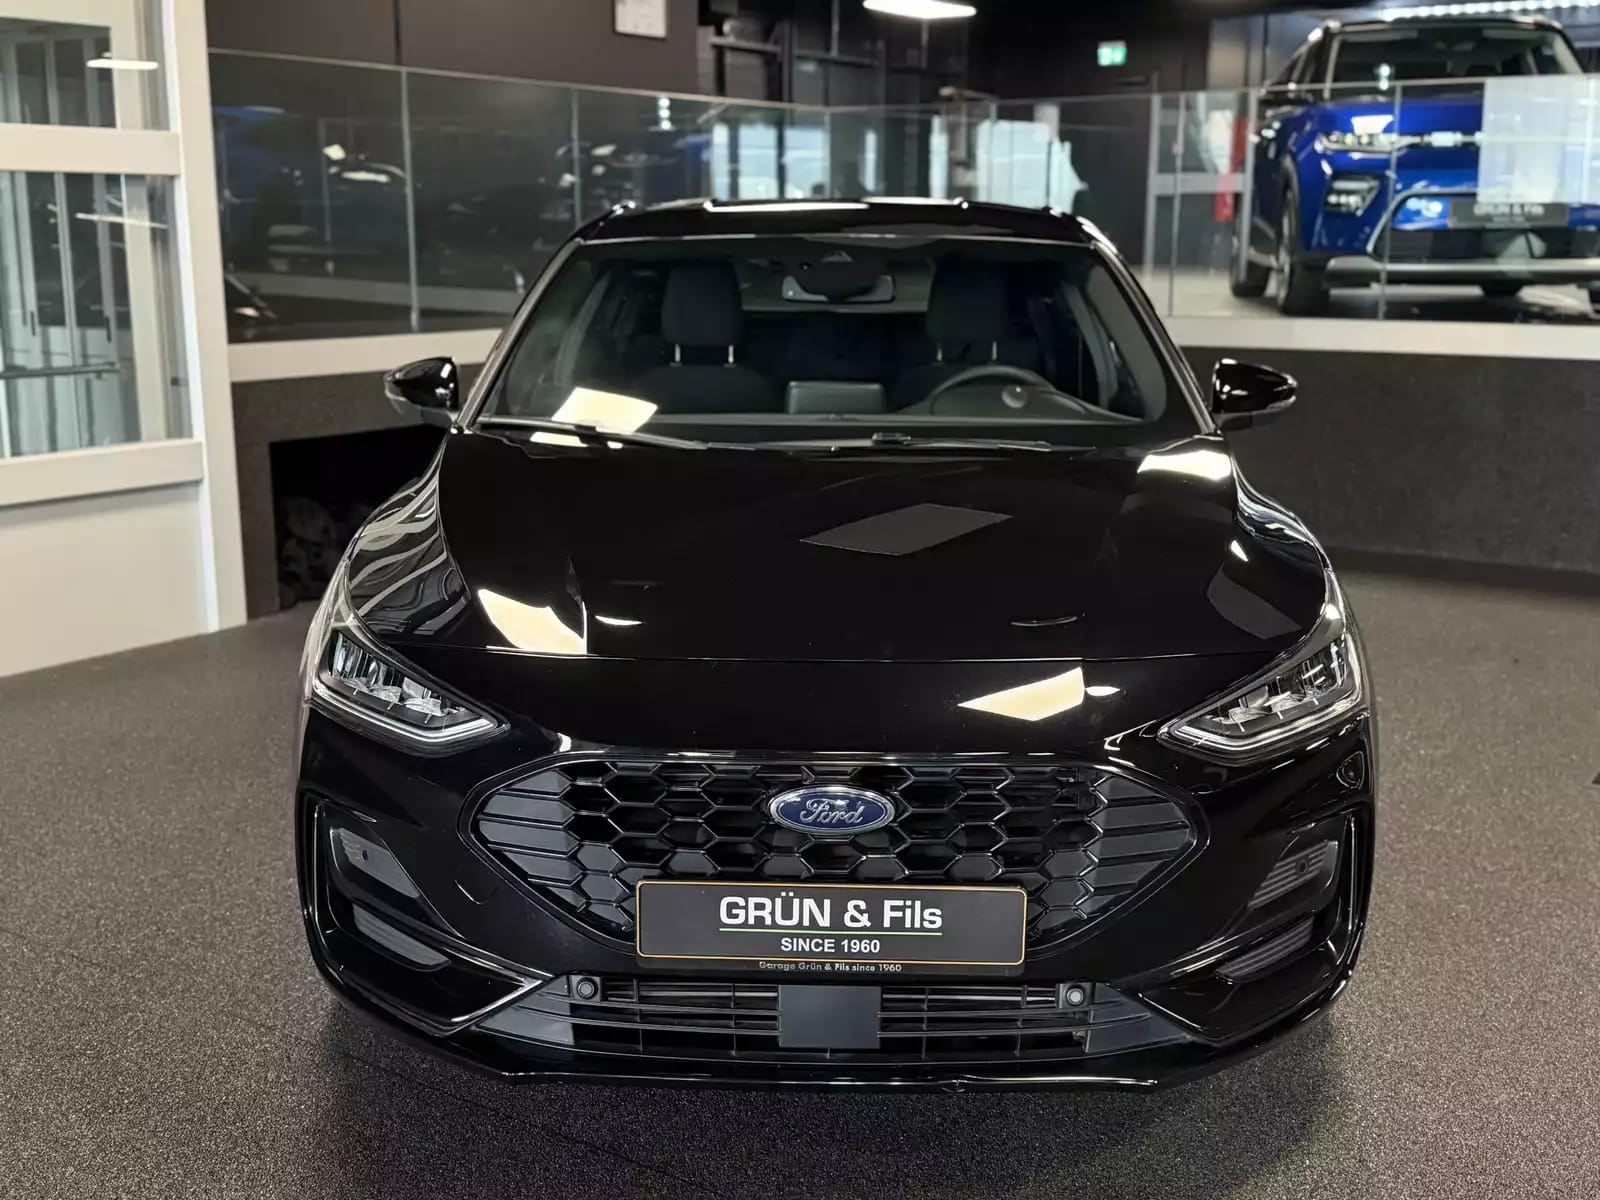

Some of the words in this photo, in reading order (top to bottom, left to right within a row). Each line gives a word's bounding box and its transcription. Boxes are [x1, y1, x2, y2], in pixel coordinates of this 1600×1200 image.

[800, 798, 865, 823] Ford
[719, 891, 831, 927] GRÜN
[843, 899, 872, 928] &
[883, 900, 943, 929] Fils
[780, 937, 835, 953] SINCE
[841, 939, 880, 953] 1960
[759, 961, 796, 971] Garage
[798, 962, 822, 971] Grün
[824, 963, 832, 971] &
[834, 963, 850, 971] Fils
[851, 963, 876, 972] since
[878, 963, 902, 972] 1960
